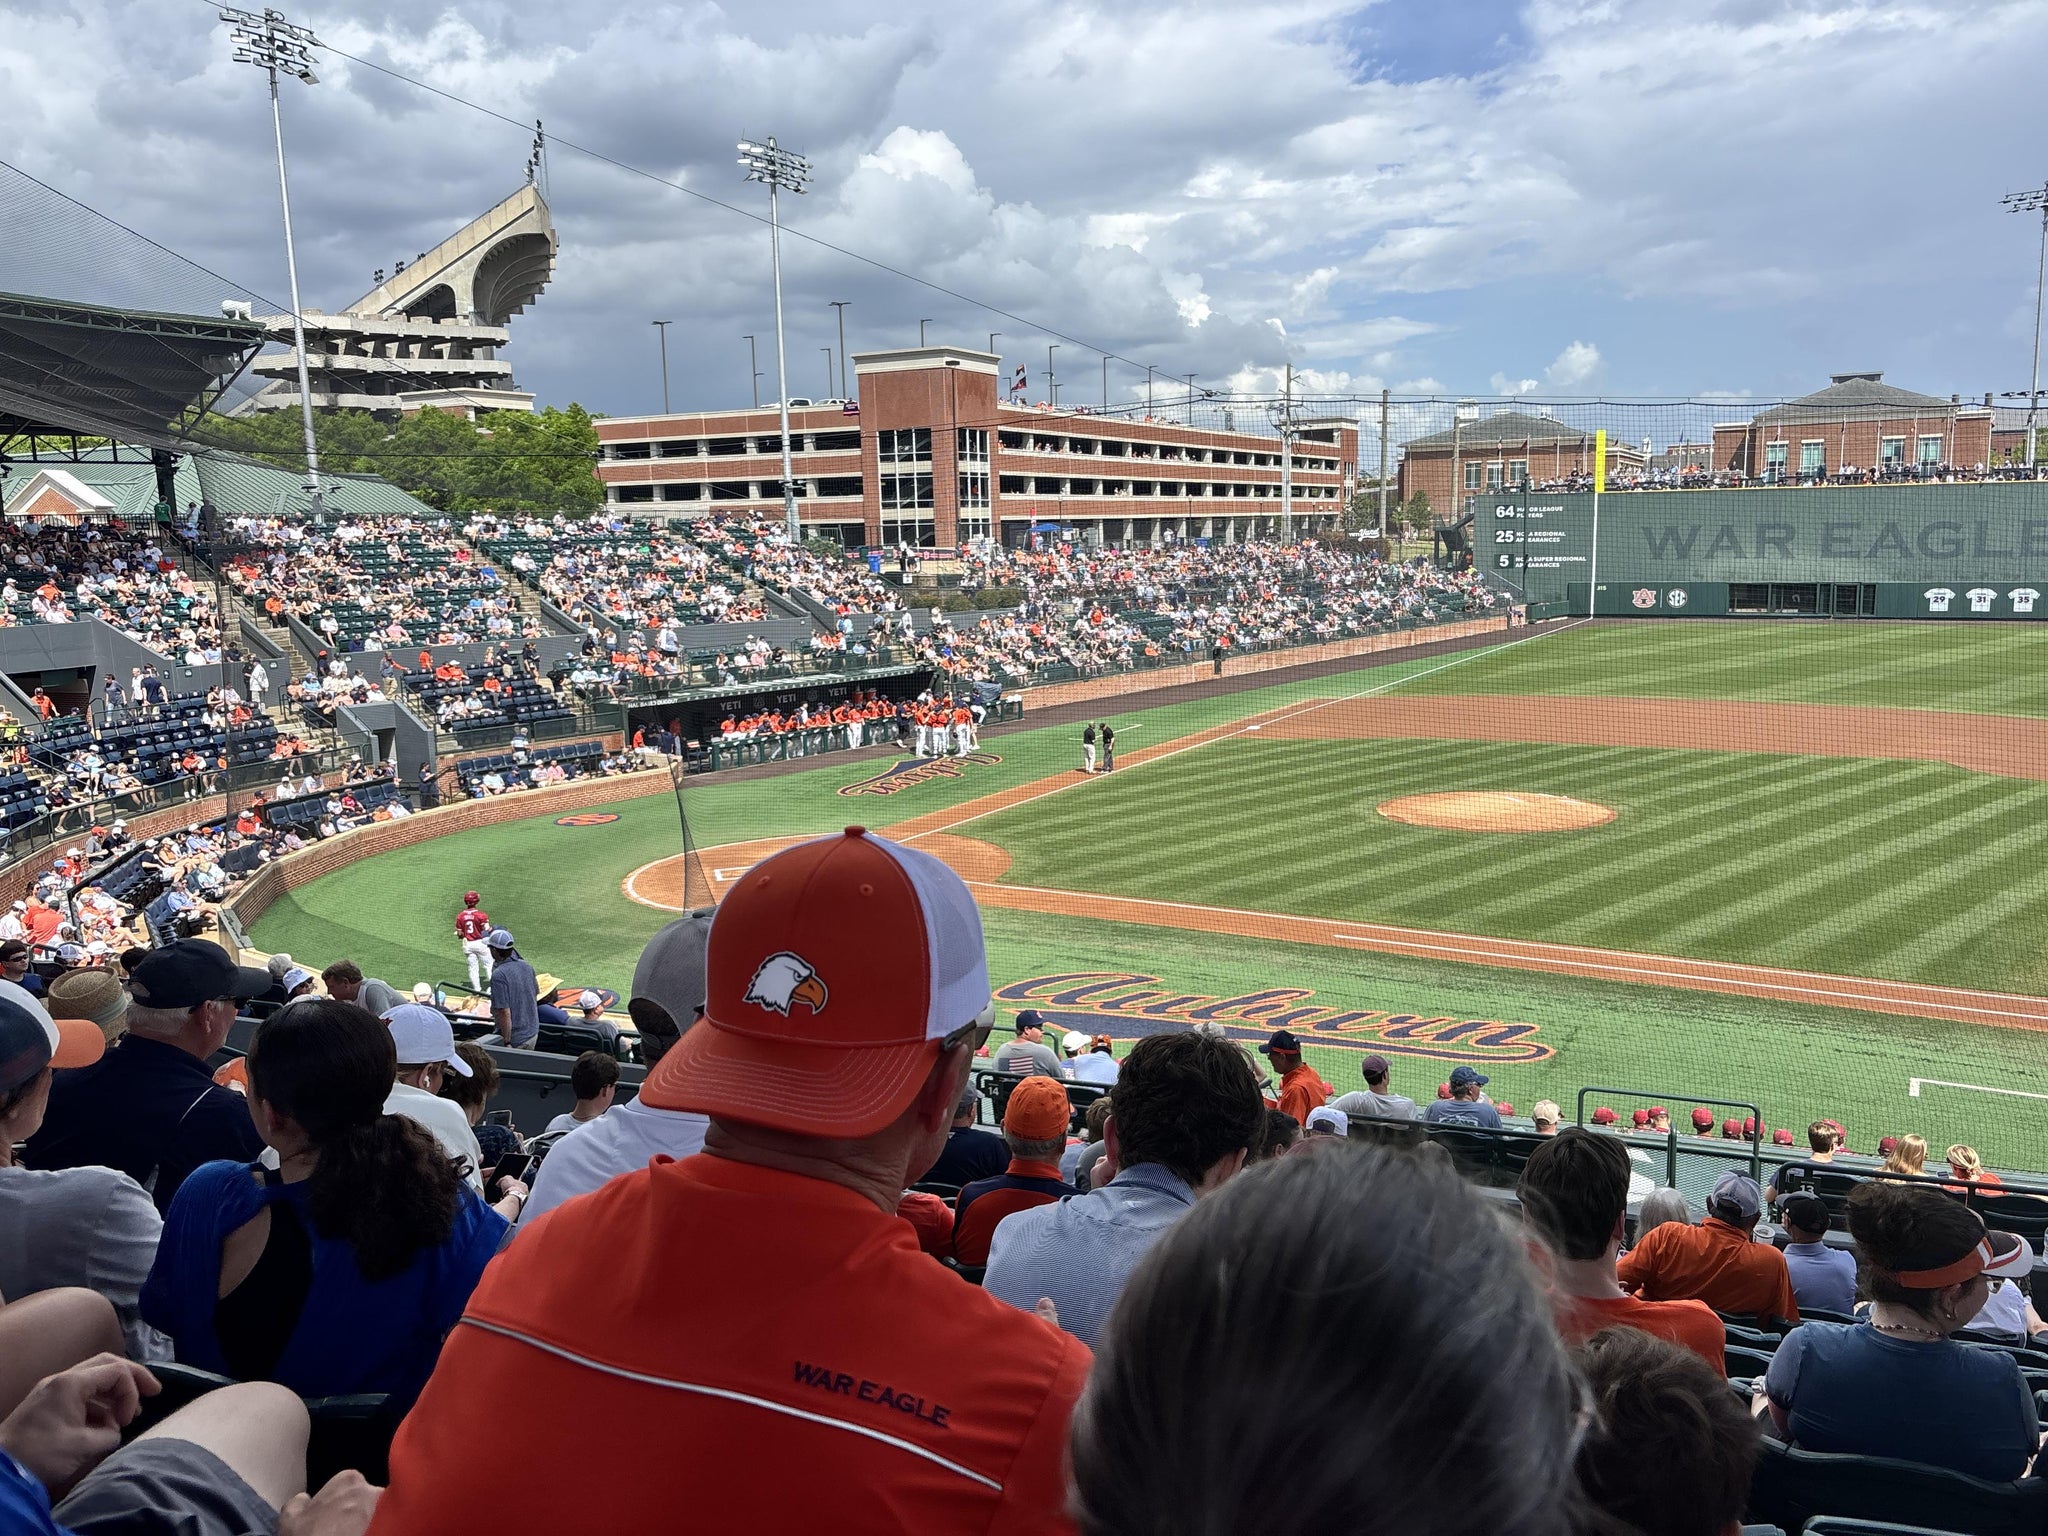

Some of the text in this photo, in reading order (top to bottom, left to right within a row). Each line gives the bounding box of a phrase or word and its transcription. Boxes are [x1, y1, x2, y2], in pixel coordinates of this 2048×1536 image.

[1495, 505, 1515, 518] 64
[1495, 530, 1514, 543] 25
[1641, 520, 2048, 560] WAR EAGLE
[1499, 554, 1509, 568] 5
[1668, 589, 1686, 607] SEC
[828, 687, 847, 697] YETI
[720, 700, 742, 711] YETI
[776, 694, 797, 704] YETI
[465, 920, 474, 934] 3
[992, 971, 1557, 1063] Auburn
[987, 1086, 1000, 1096] 14
[793, 1360, 951, 1428] WAR EAGLE
